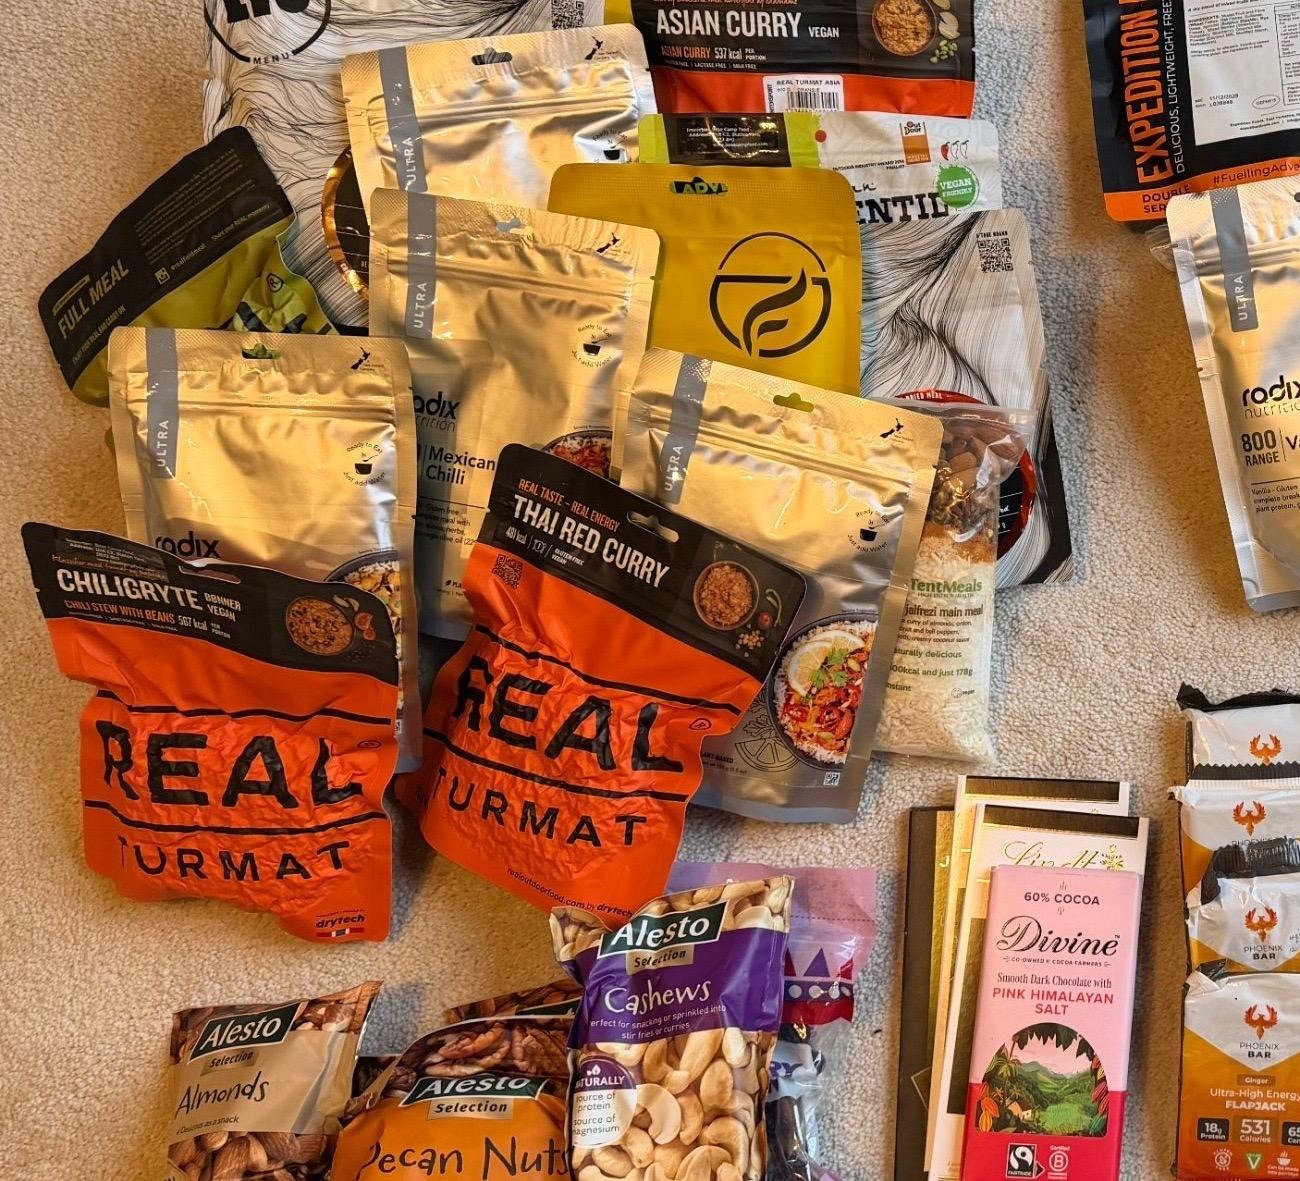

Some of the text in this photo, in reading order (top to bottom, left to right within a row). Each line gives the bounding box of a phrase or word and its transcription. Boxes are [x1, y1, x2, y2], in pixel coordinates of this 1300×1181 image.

[657, 9, 840, 38] ASIAN CURRY VEGAN
[252, 52, 290, 65] MENU
[684, 47, 728, 60] CURRY 537
[1120, 9, 1174, 184] EXPEDITION
[1164, 27, 1186, 174] DELICIOUS, LIGHTWEIGHT,
[402, 137, 416, 182] ULTRA
[939, 177, 971, 190] VEGAN
[1142, 185, 1190, 203] DOUBLE
[57, 296, 91, 340] FULL
[89, 257, 130, 306] MEAL
[413, 282, 427, 329] ULTRA
[1234, 275, 1249, 321] ULTRA
[157, 419, 170, 468] ULTRA
[1241, 429, 1278, 452] 800
[428, 446, 496, 472] Mexican
[664, 446, 684, 493] ULTRA
[1245, 451, 1280, 467] RANGE
[425, 465, 466, 486] Chilli
[519, 478, 621, 533] REAL TASTE REAL ENERGY
[155, 531, 221, 558] radix
[514, 494, 558, 541] THAI
[559, 515, 600, 555] RED
[602, 537, 672, 589] CURRY
[56, 568, 204, 611] CHILIGRYTE
[911, 578, 983, 593] TentMeals
[64, 600, 175, 625] CHILI STEW WITH BEANS
[207, 604, 237, 622] VEGAN
[939, 604, 984, 617] main meal
[925, 649, 963, 659] delicious
[451, 653, 685, 774] REAL
[96, 720, 364, 809] REAL
[433, 766, 648, 848] TURMAT
[117, 834, 351, 882] TURMAT
[507, 866, 586, 912] realoutdoorfood.com
[1024, 891, 1100, 906] 60% COCOA
[315, 914, 365, 928] drytech
[610, 916, 710, 948] Alesto
[996, 915, 1119, 957] Divine
[634, 949, 687, 969] Selection
[997, 972, 1112, 989] Smooth Dark Chocolate with
[603, 978, 712, 1017] Cashews
[992, 987, 1114, 1005] PINK HIMALAYAN
[631, 1005, 710, 1031] snacking sprinkled
[1035, 1002, 1069, 1016] SALT
[200, 1016, 283, 1051] Alesto
[1239, 1041, 1280, 1051] PHOENIX
[1247, 1050, 1272, 1059] BAR
[209, 1051, 254, 1069] Selection
[416, 1077, 533, 1099] Alesto
[1244, 1076, 1269, 1085] Ginger
[174, 1070, 270, 1121] Almonds
[575, 1091, 605, 1102] source
[1210, 1088, 1265, 1101] Ultra-High
[435, 1100, 508, 1114] Selection
[577, 1101, 611, 1113] protein
[1225, 1100, 1286, 1112] FLAPJACK
[572, 1115, 604, 1126] source
[1240, 1118, 1271, 1135] 531
[1200, 1132, 1226, 1141] Protein
[1239, 1134, 1272, 1144] Calories
[482, 1135, 569, 1181] Nuts
